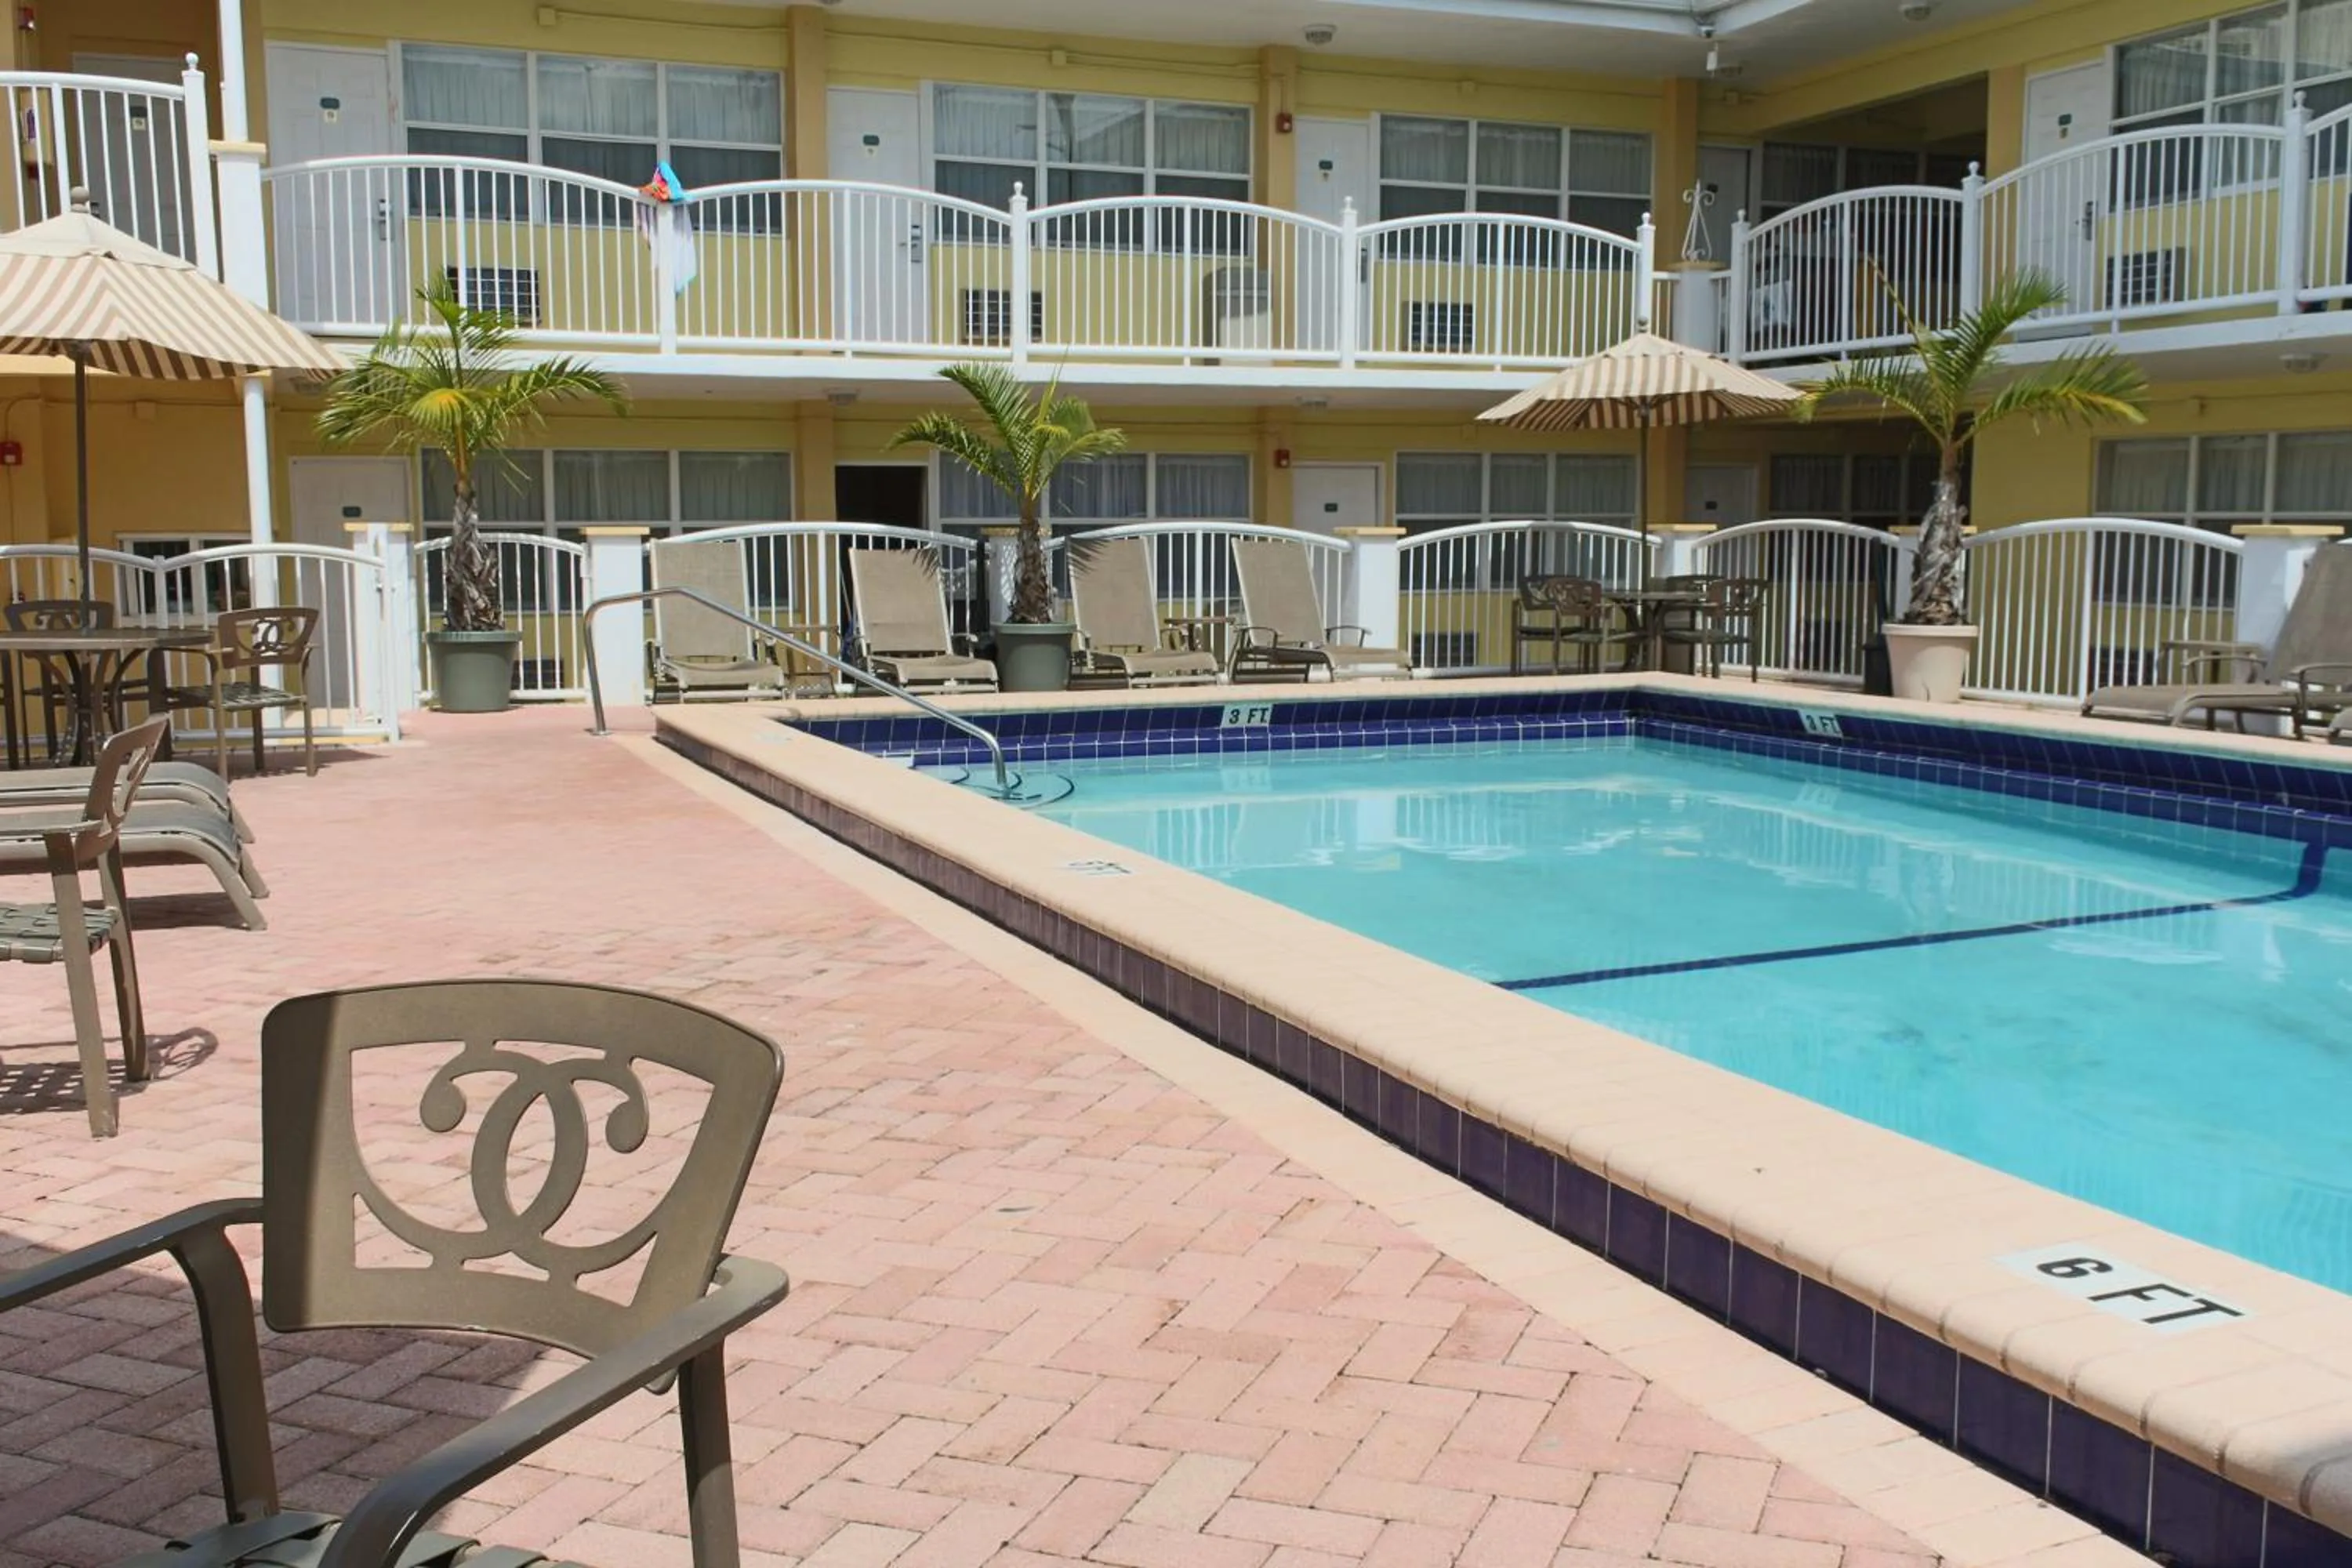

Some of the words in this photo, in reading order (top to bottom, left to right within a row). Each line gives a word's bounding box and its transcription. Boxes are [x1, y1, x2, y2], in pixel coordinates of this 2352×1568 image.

[1229, 708, 1240, 724] 3
[2036, 1257, 2114, 1279] 6
[2087, 1283, 2246, 1325] FT
